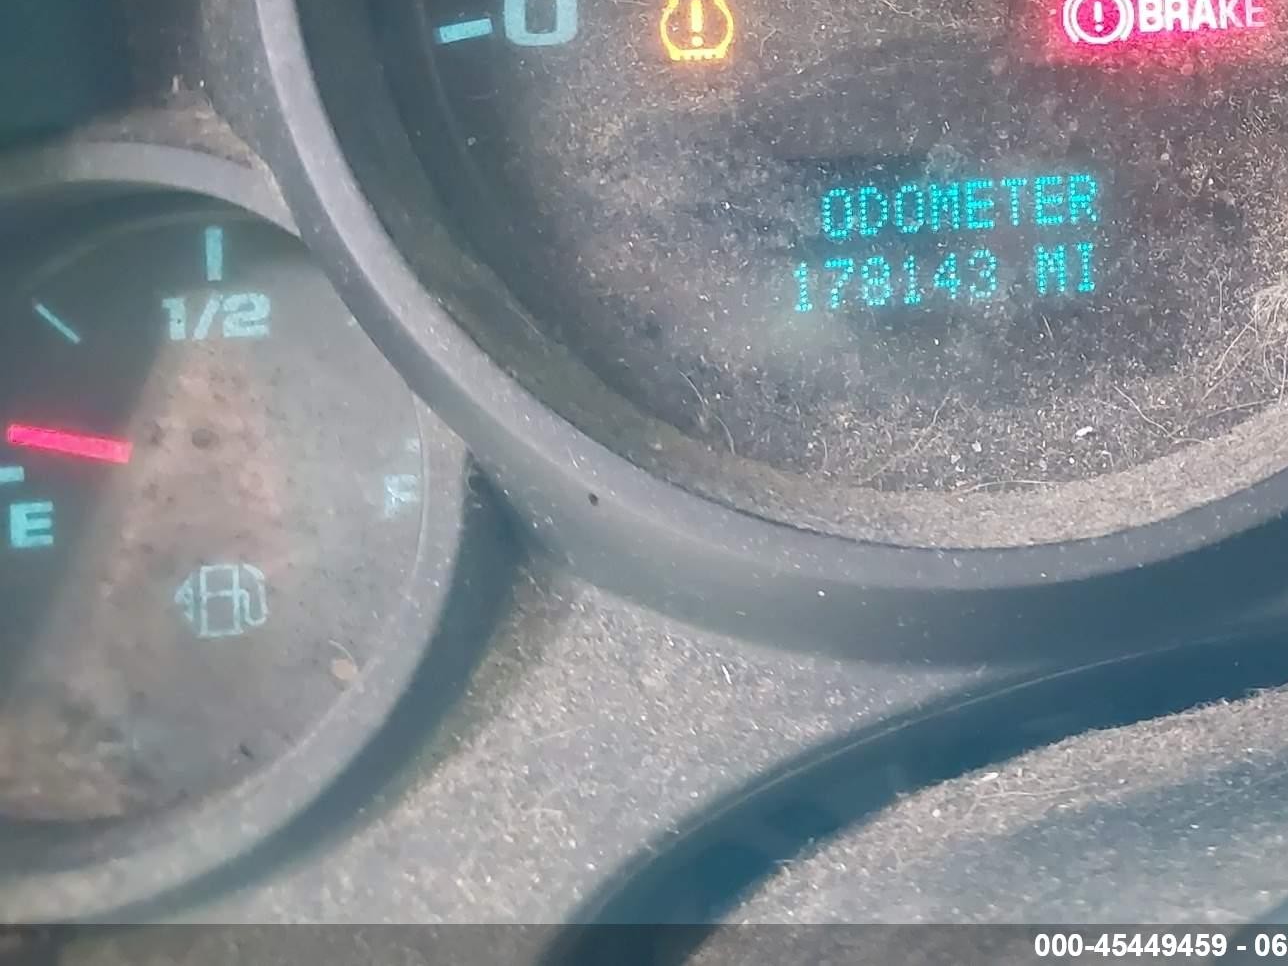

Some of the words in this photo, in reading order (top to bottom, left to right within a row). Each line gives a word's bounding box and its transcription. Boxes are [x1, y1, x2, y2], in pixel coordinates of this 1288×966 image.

[821, 173, 1098, 238] ODOMETER
[793, 249, 997, 314] 178143
[1033, 241, 1097, 297] MI
[161, 291, 271, 341] 1/2
[9, 500, 54, 548] E
